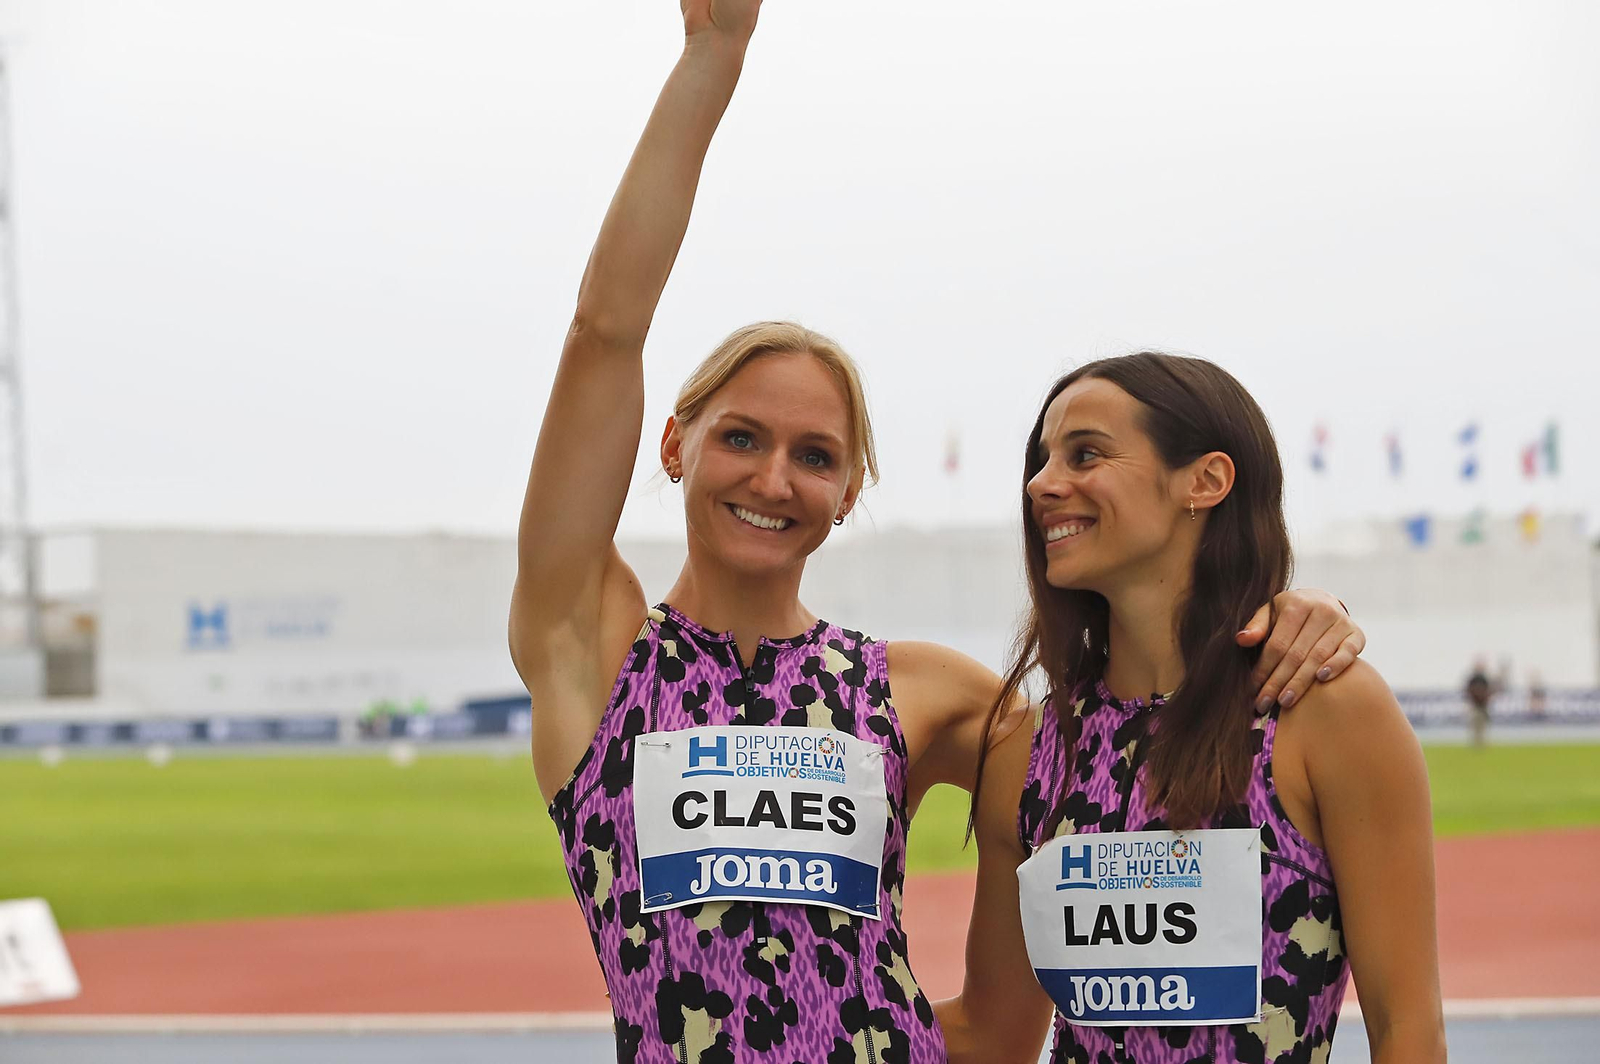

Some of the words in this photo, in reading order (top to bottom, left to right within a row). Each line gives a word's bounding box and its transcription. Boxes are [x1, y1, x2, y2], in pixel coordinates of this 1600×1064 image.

[736, 733, 846, 756] DIPUTACIÓN
[736, 752, 760, 766] DE
[770, 752, 845, 771] HUELVA
[736, 766, 807, 779] OBJETIVOS
[807, 773, 846, 784] SOSTENIBLE
[815, 768, 846, 778] DESARROLLO
[672, 790, 856, 836] CLAES
[1098, 835, 1202, 859] DIPUTACIÓN
[1098, 861, 1118, 877] DE
[1127, 859, 1201, 876] HUELVA
[1099, 876, 1160, 891] OBJETIVOS
[1160, 880, 1202, 889] SOSTENIBLE
[1064, 902, 1198, 946] LAUS
